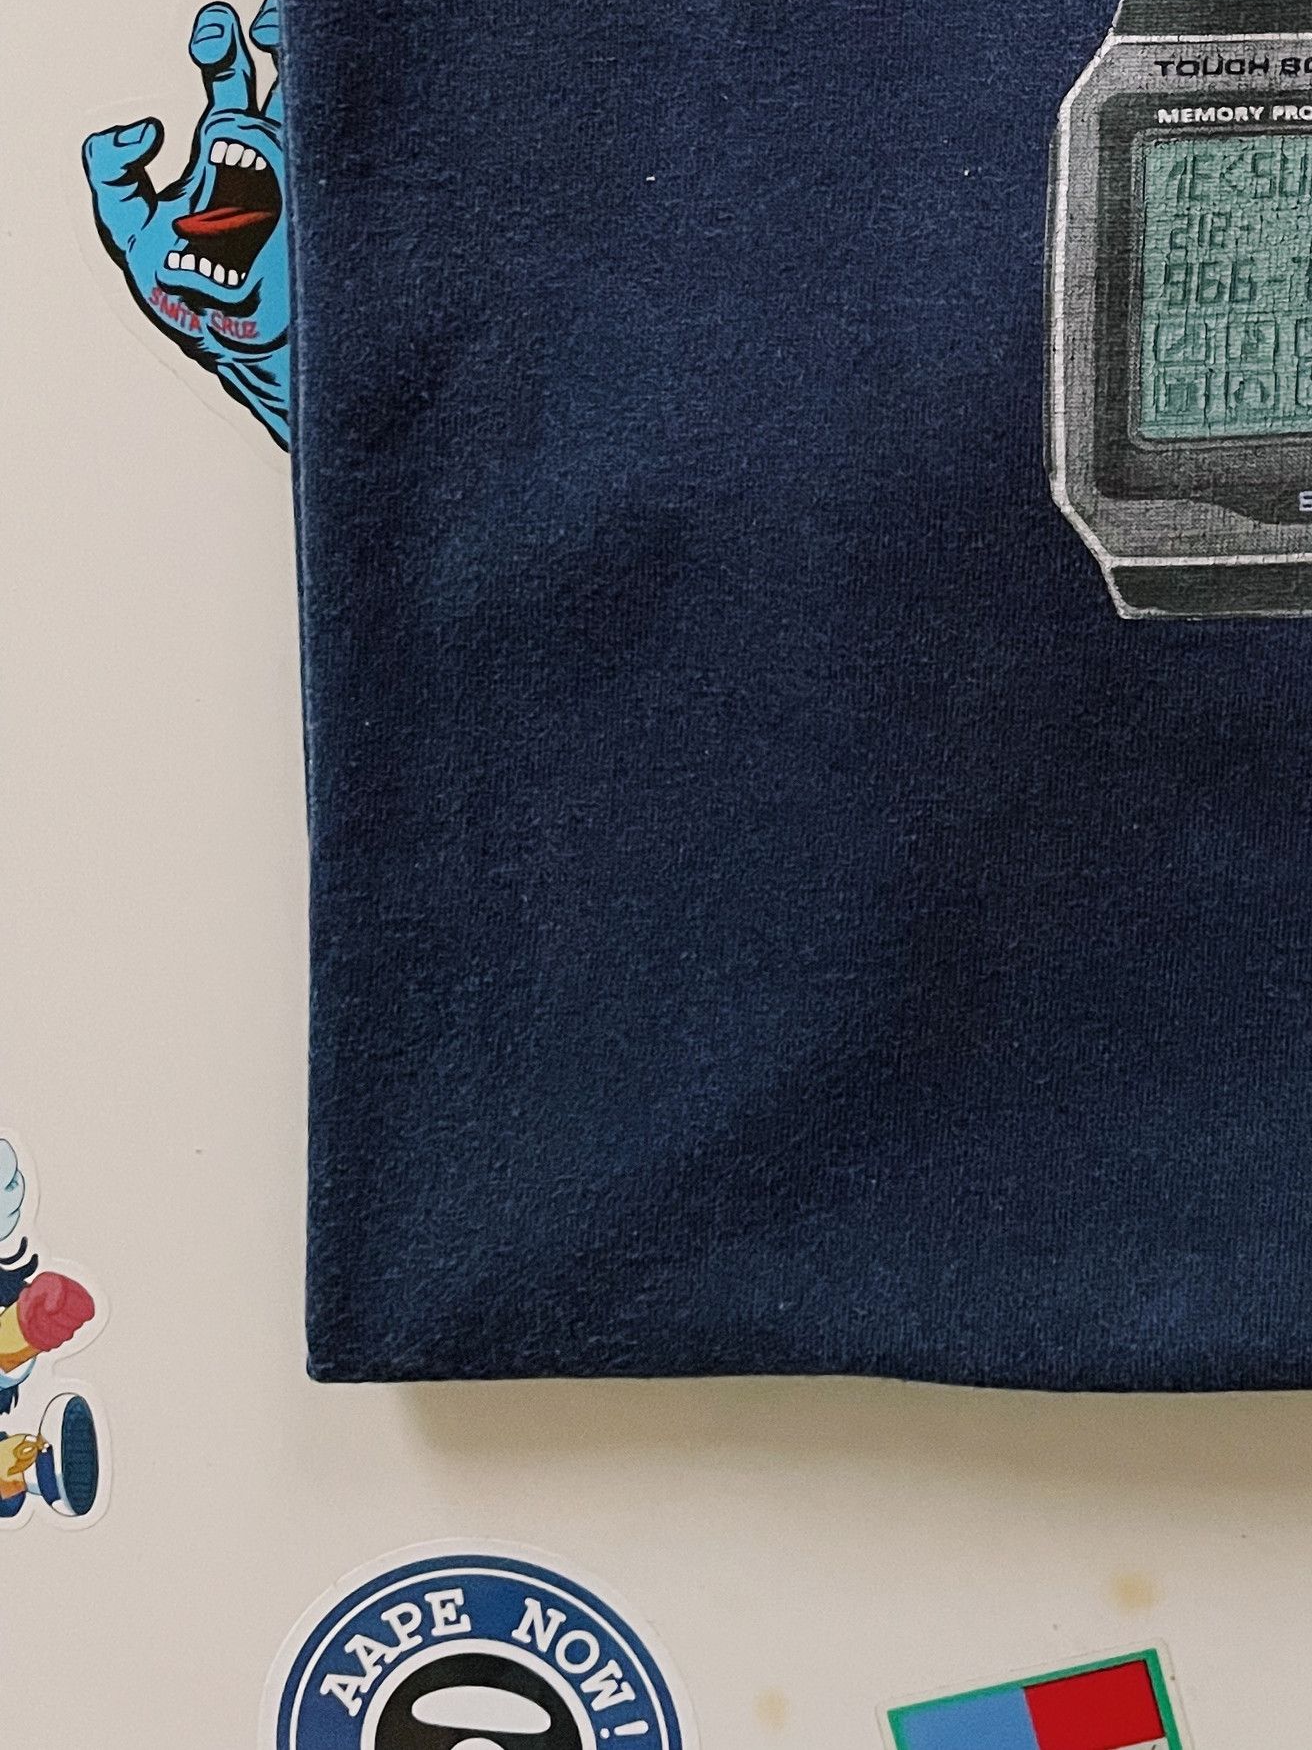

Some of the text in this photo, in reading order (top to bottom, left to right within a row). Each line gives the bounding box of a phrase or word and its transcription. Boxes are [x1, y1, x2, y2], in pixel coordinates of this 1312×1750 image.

[1154, 56, 1270, 78] TOUCH
[1156, 106, 1264, 124] MEMORY
[149, 286, 260, 339] SANTA CRUZ
[320, 1588, 650, 1740] AAPE NOW!
